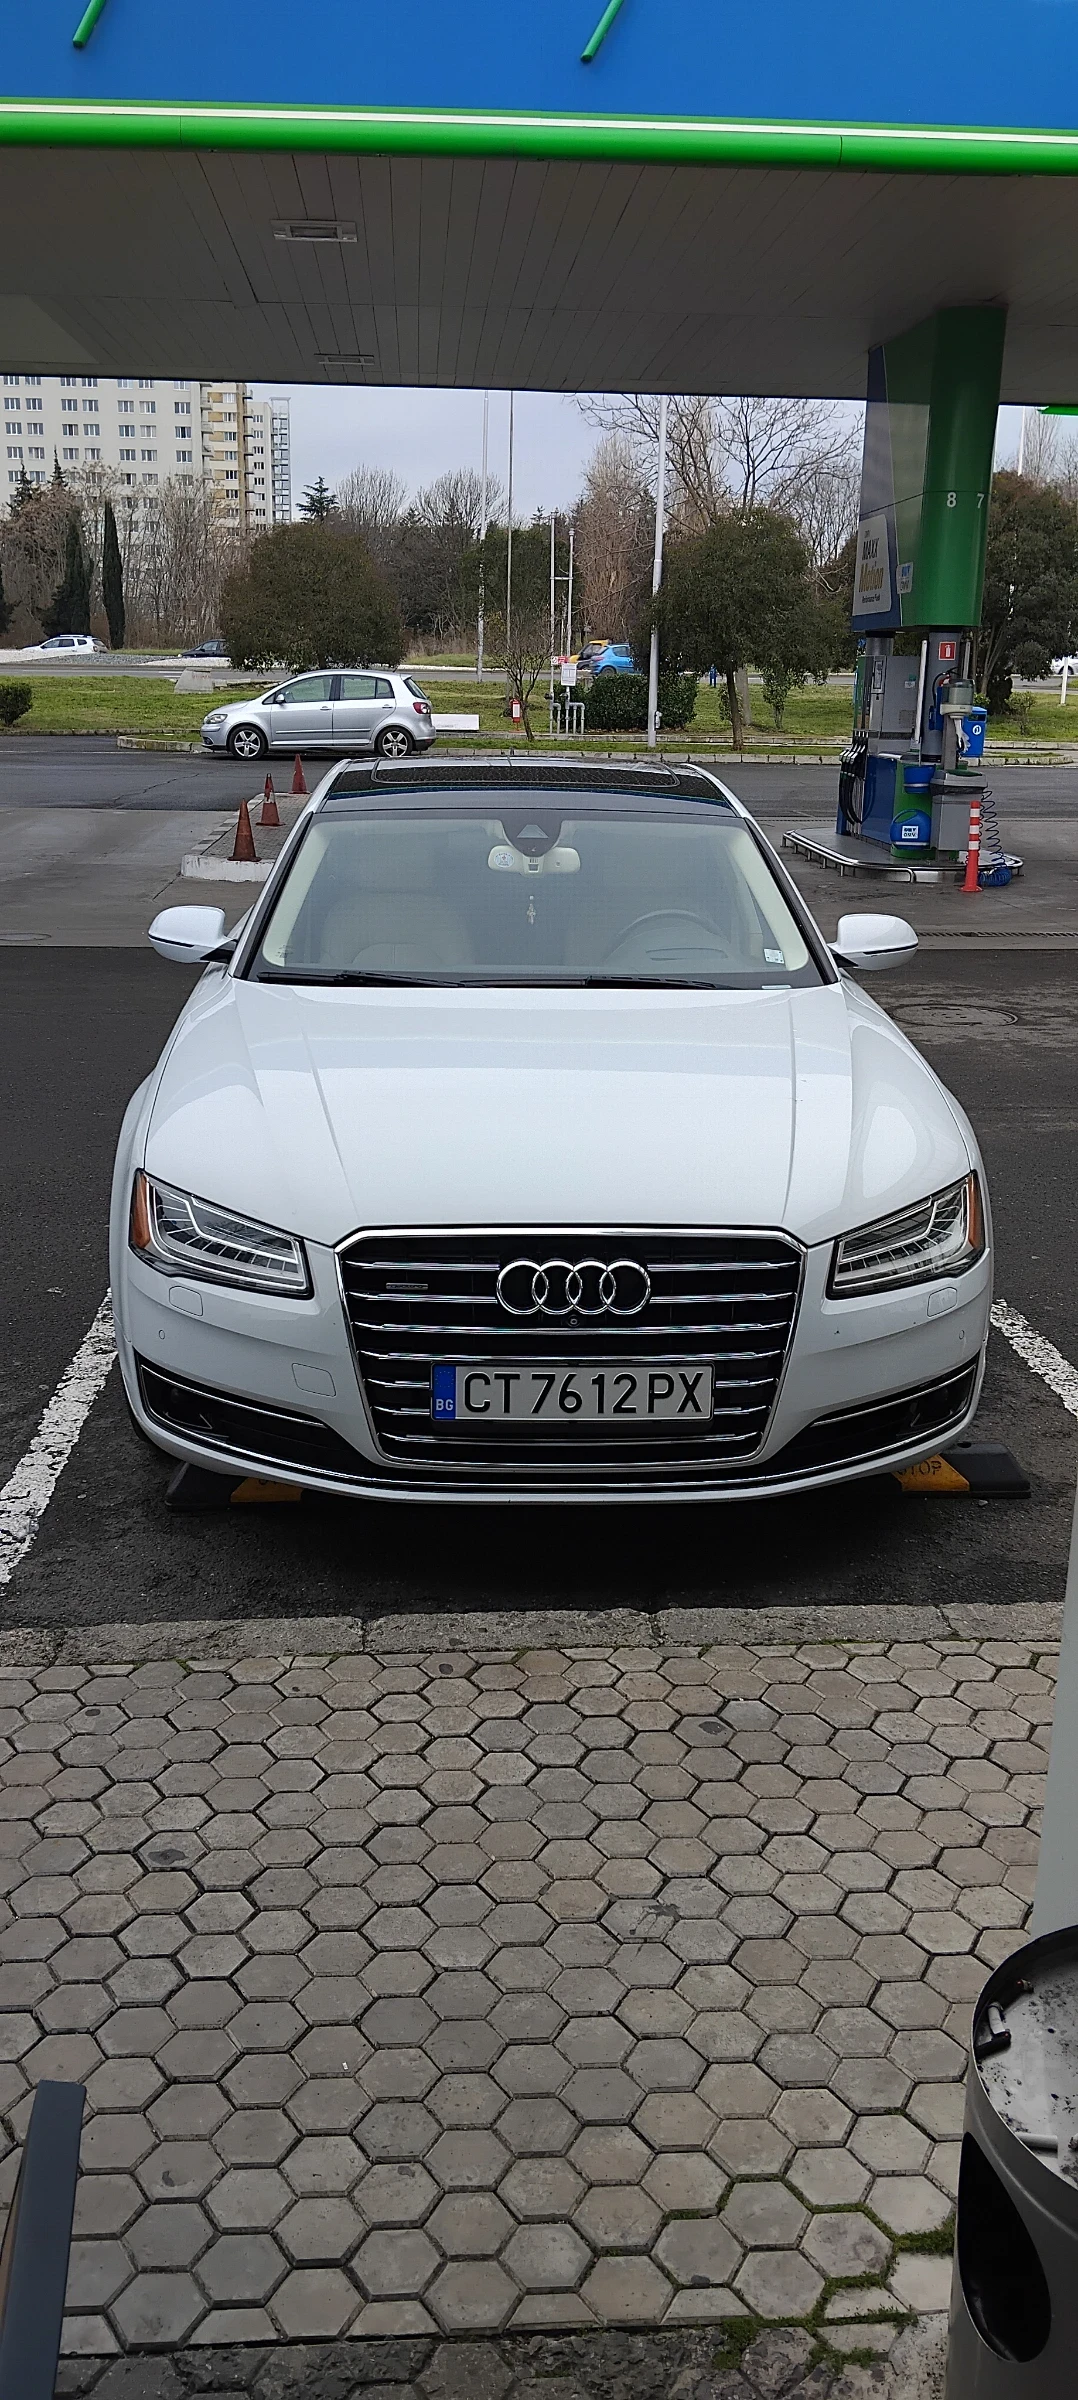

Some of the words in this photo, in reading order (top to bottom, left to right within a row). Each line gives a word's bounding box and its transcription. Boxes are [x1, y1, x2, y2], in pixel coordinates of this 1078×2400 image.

[946, 492, 956, 508] 8
[977, 492, 985, 509] 7
[435, 1399, 454, 1411] BG
